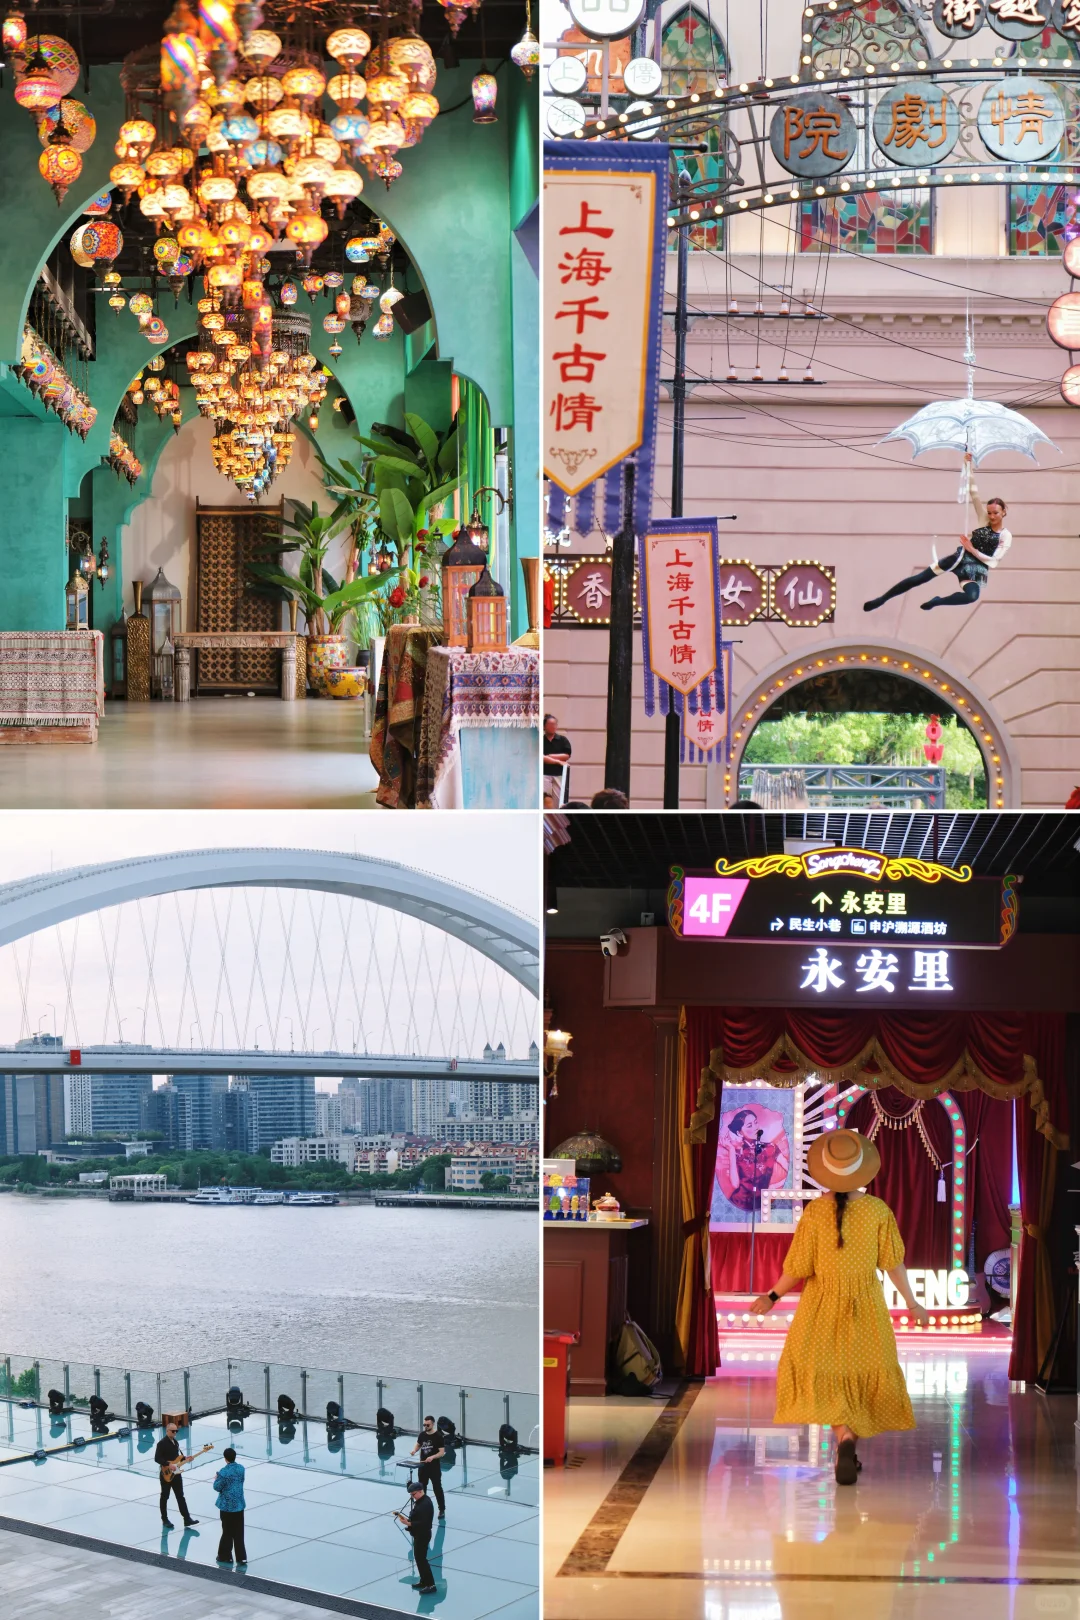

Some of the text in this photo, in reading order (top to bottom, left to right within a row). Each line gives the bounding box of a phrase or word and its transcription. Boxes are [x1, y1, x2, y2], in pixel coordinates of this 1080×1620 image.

[549, 201, 614, 433] 上海千古情
[665, 548, 697, 665] 上海千古情
[689, 892, 732, 924] 4F
[839, 890, 908, 915] 永安里
[789, 917, 948, 935] 民生小巷 申沪溯源酒坊
[799, 947, 954, 993] 永安里
